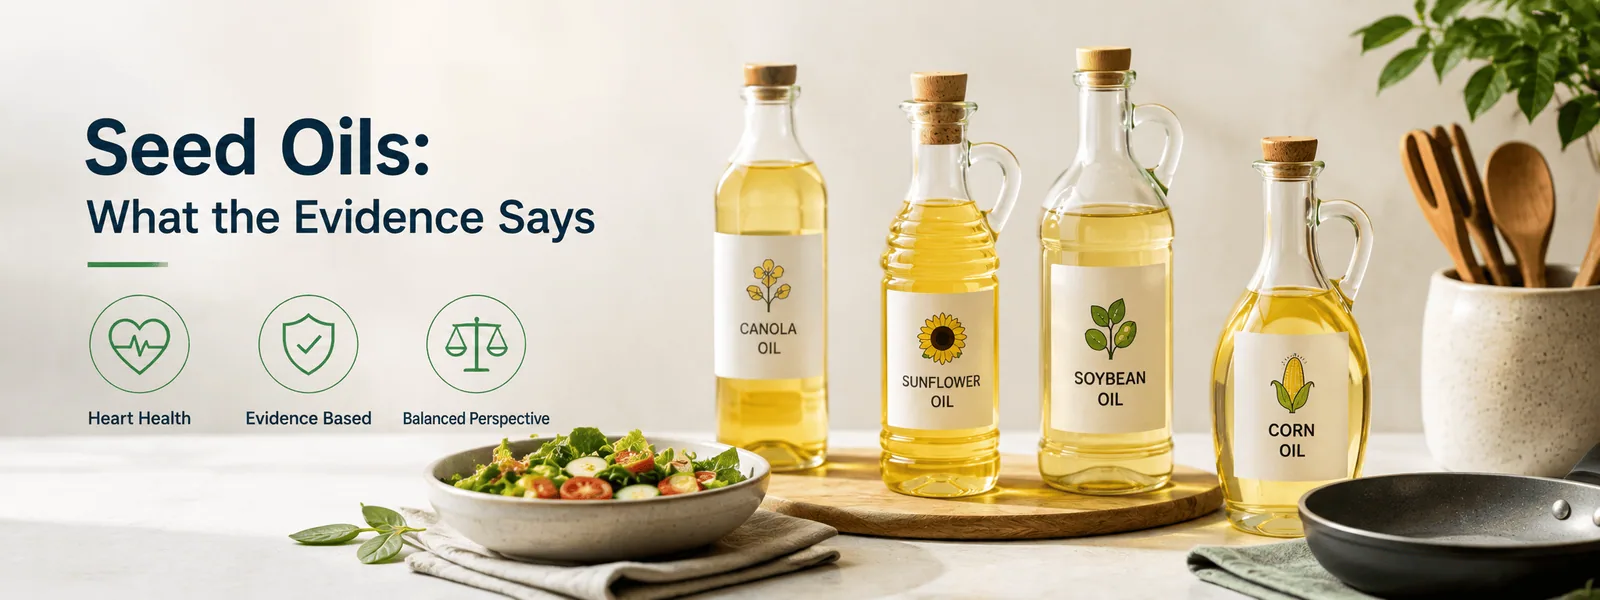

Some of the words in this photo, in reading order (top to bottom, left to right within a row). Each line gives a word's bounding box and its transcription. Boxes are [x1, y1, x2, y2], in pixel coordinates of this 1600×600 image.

[739, 322, 798, 336] CANOLA
[757, 341, 782, 355] OIL
[902, 374, 981, 389] SUNFLOWER
[1074, 370, 1147, 386] SOYBEAN
[930, 394, 955, 409] OIL
[1097, 391, 1124, 407] OIL
[1268, 422, 1315, 438] CORN
[1279, 443, 1306, 458] OIL
